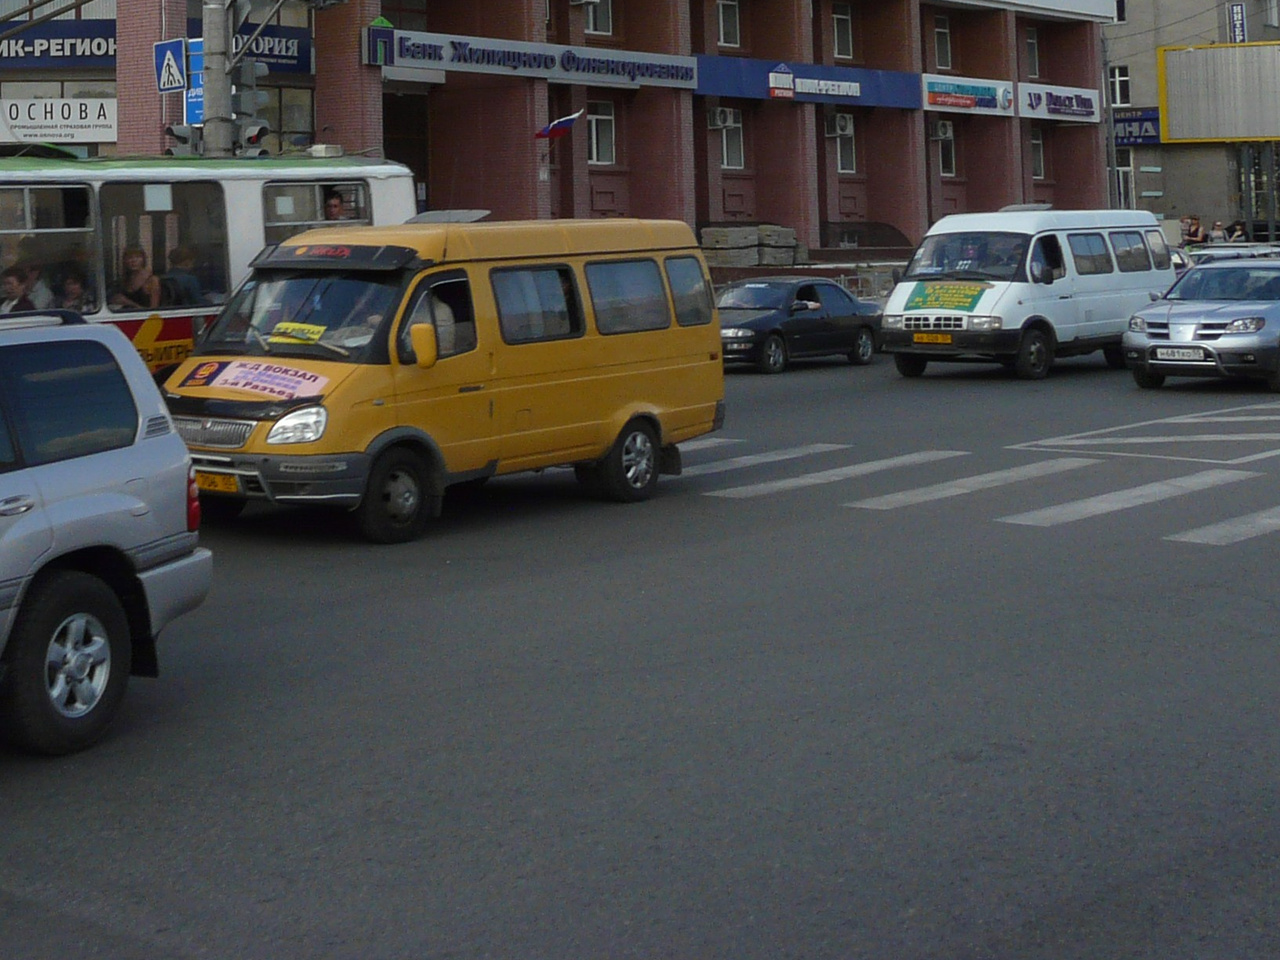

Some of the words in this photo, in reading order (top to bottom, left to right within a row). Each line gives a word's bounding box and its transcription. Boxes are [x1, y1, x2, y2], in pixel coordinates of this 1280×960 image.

[398, 35, 444, 61] Банк
[449, 40, 556, 71] Жилищного
[560, 50, 696, 81] Финансирования
[9, 102, 108, 121] ОСНОВА
[263, 363, 319, 383] ВОКЗАЛ
